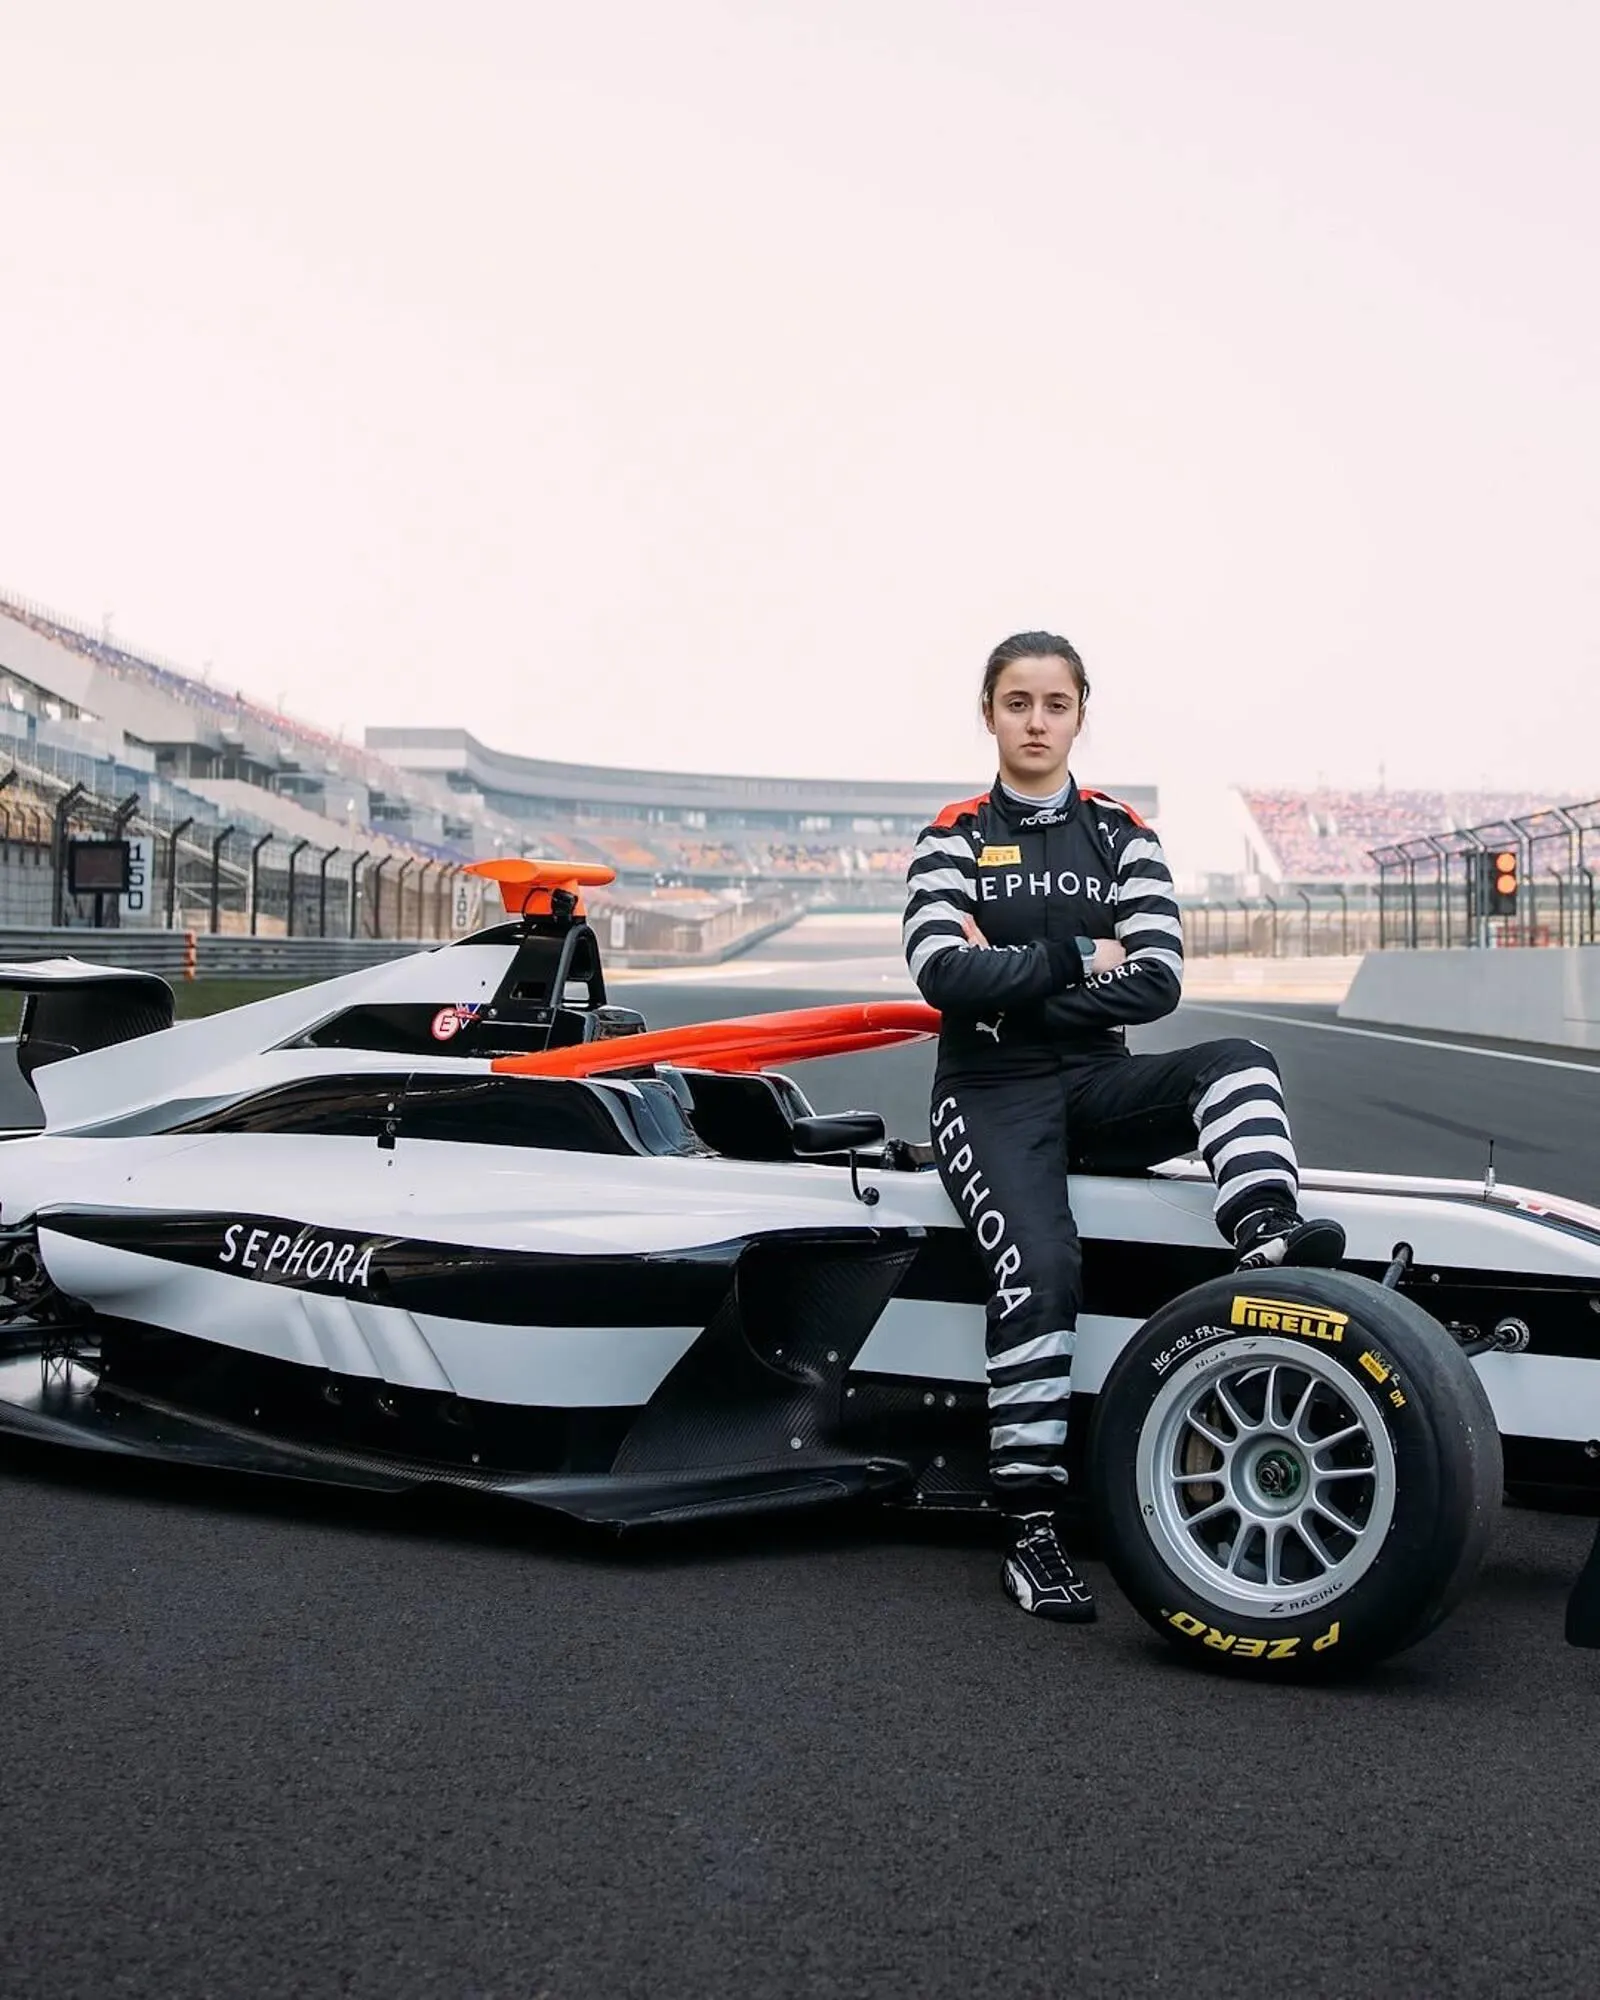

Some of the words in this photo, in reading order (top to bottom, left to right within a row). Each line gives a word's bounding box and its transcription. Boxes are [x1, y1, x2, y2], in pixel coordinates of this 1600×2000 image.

[1020, 811, 1068, 826] ACADEMY
[456, 887, 467, 928] 100
[981, 871, 1119, 906] EPHORA
[932, 1096, 1033, 1320] SEPHORA
[218, 1223, 374, 1287] SEPHORA
[1231, 1295, 1349, 1342] PIRELLI
[1289, 1582, 1344, 1611] RACING
[1167, 1610, 1301, 1660] ZERO
[1312, 1620, 1340, 1652] P
